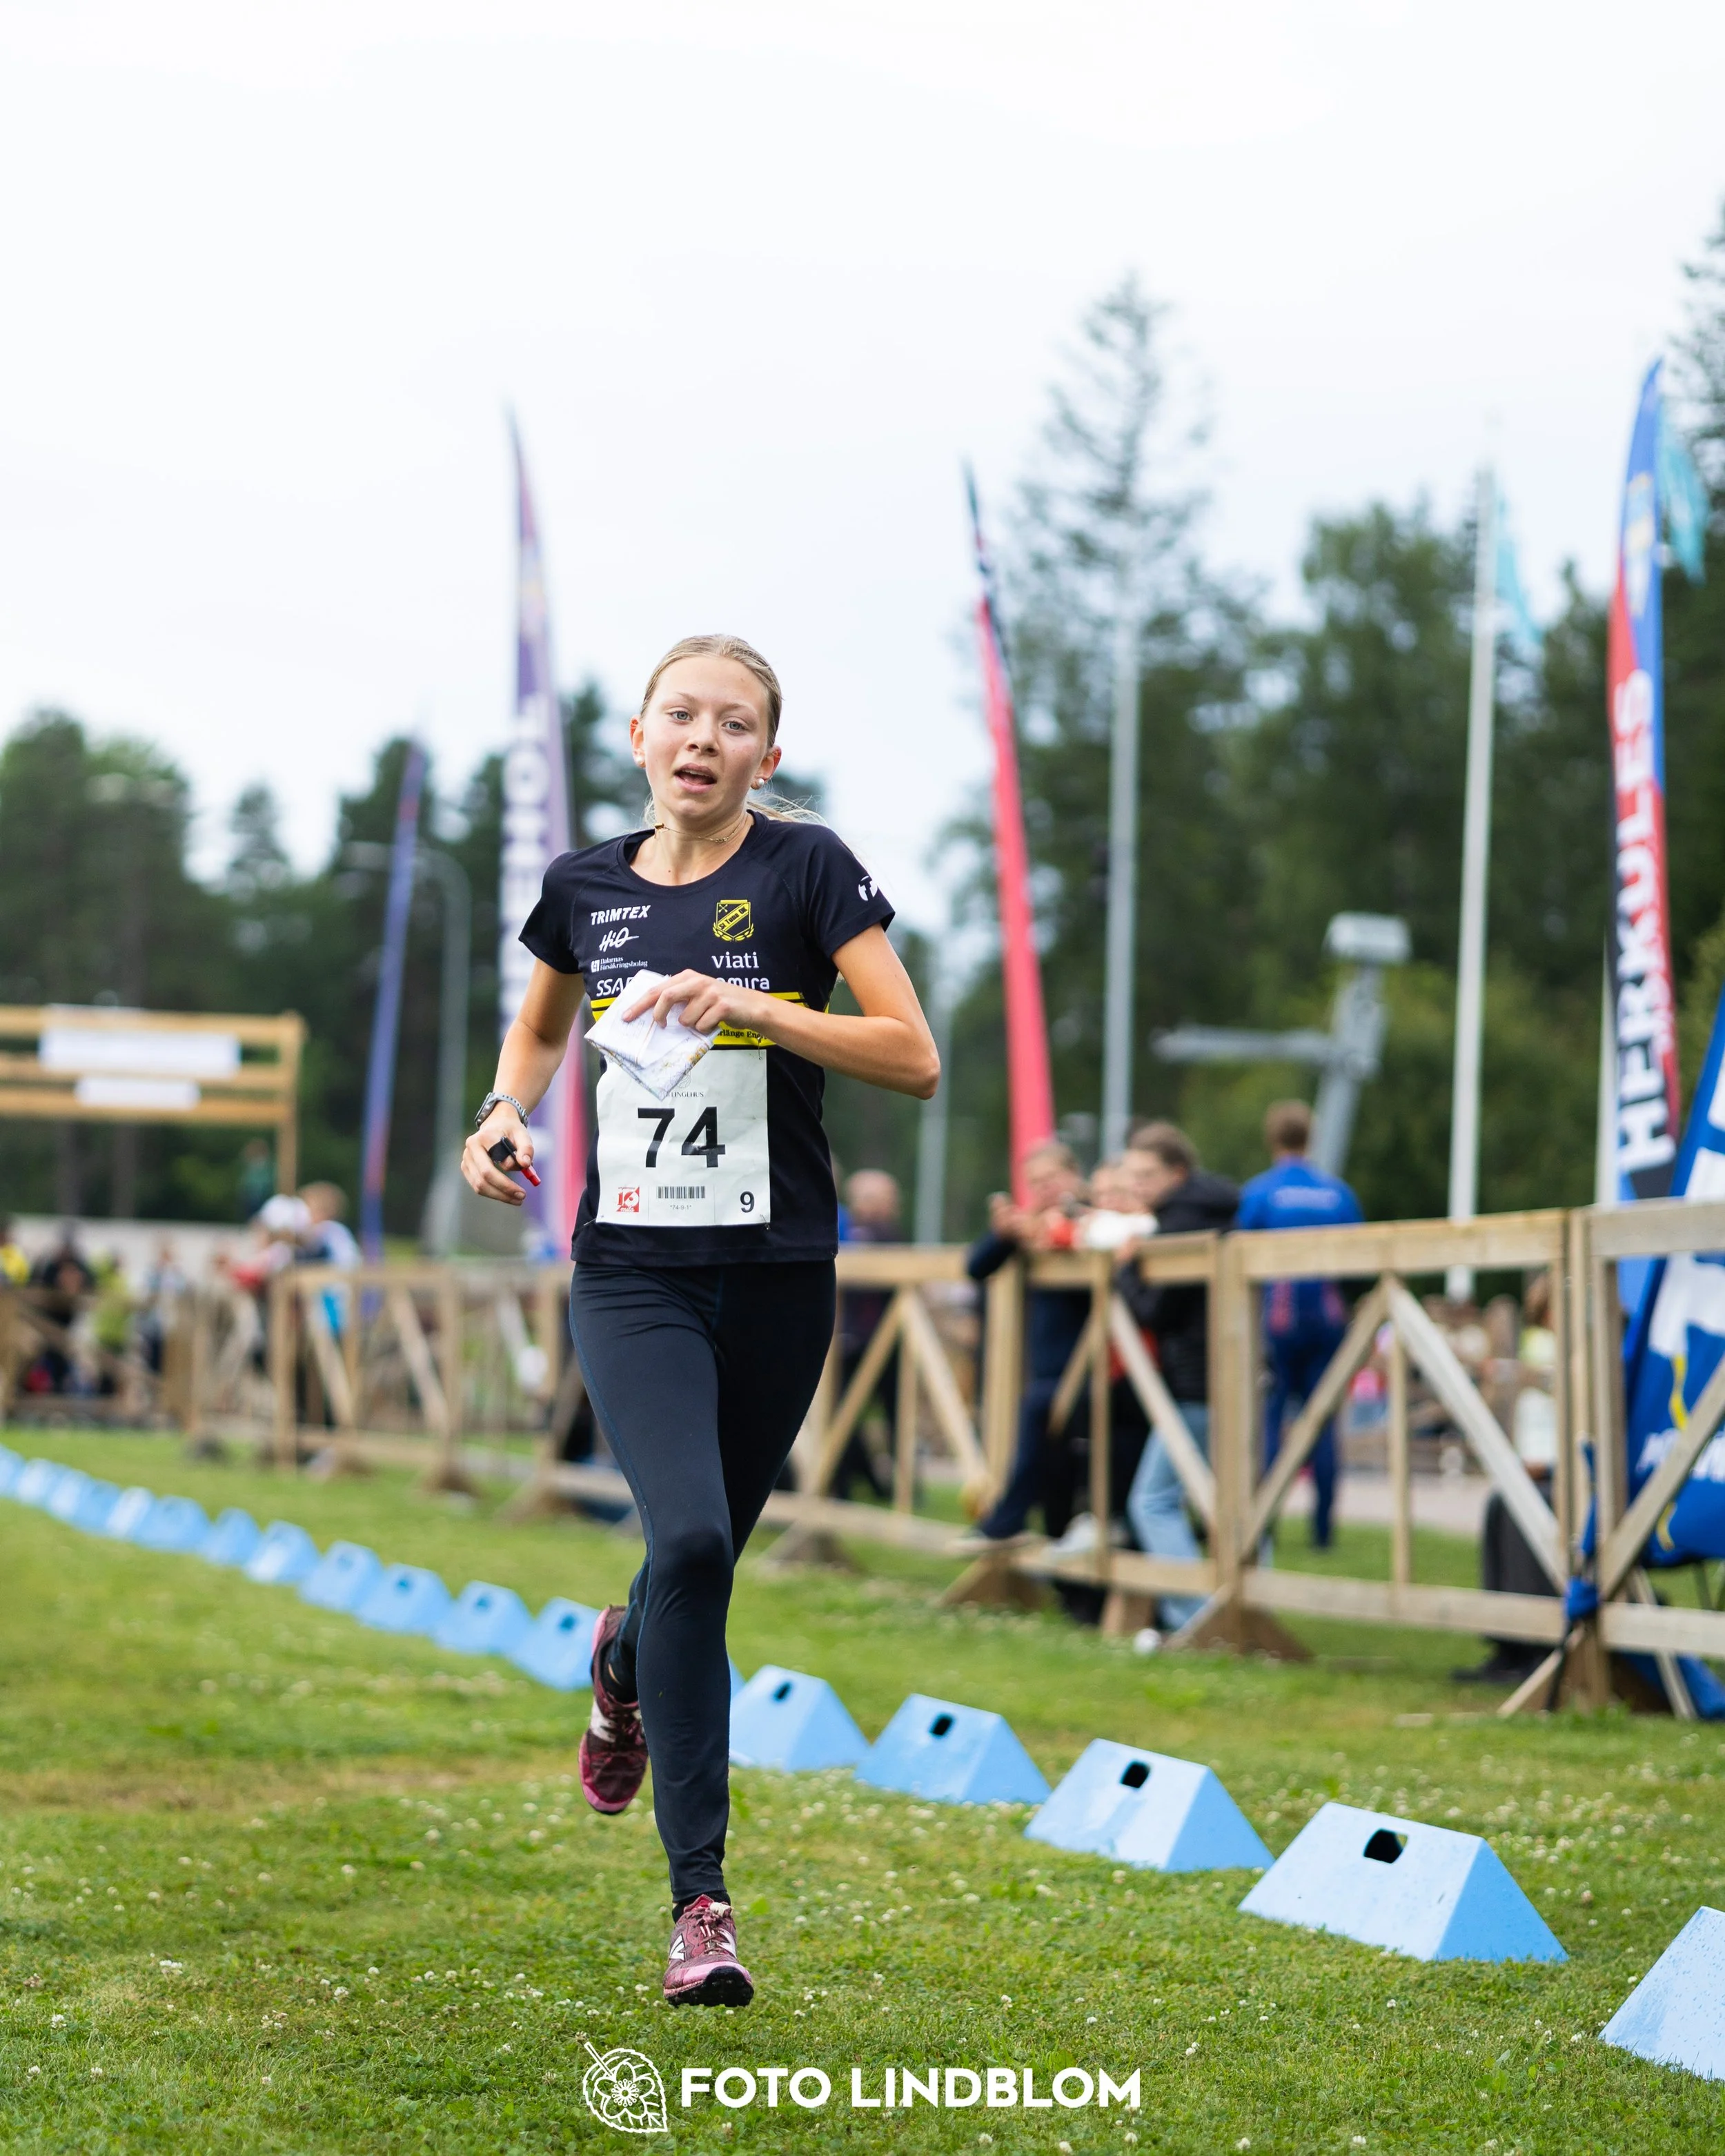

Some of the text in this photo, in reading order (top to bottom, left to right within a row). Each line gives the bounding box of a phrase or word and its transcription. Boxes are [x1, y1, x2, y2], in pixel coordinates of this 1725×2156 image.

[591, 905, 651, 925] TRIMTEX
[600, 956, 624, 965] Dalarnas
[711, 951, 759, 969] viati
[638, 1106, 726, 1167] 74
[740, 1191, 755, 1213] 9
